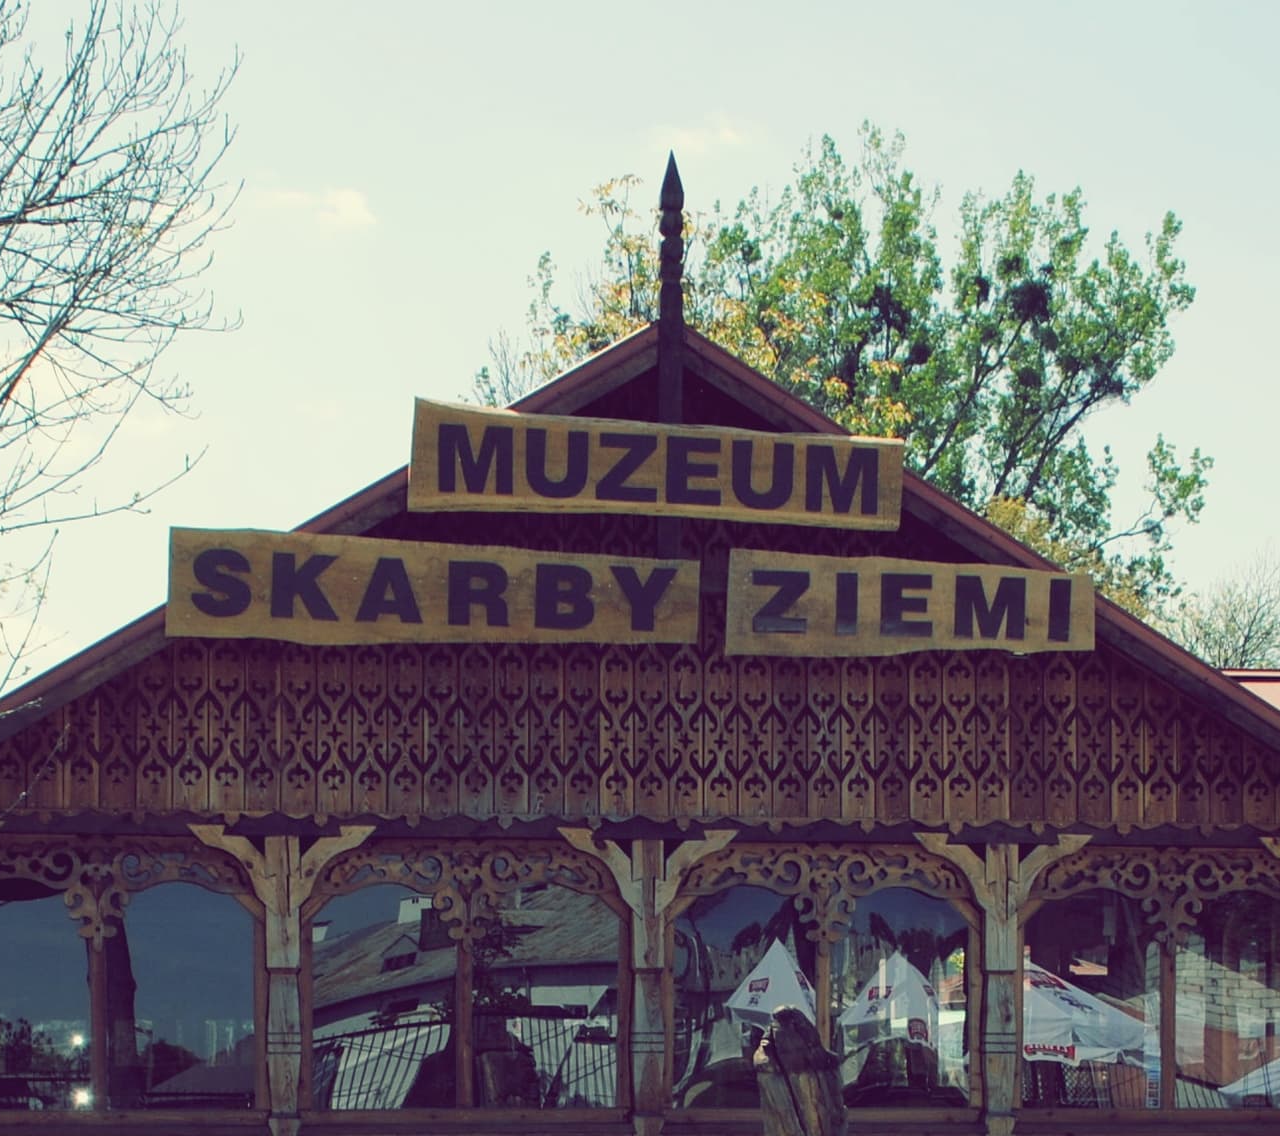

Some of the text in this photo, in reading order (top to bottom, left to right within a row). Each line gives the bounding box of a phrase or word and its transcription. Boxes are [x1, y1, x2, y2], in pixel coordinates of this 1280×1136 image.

[438, 423, 879, 515] MUZEUM
[191, 548, 1072, 642] SKARBY ZIEMI
